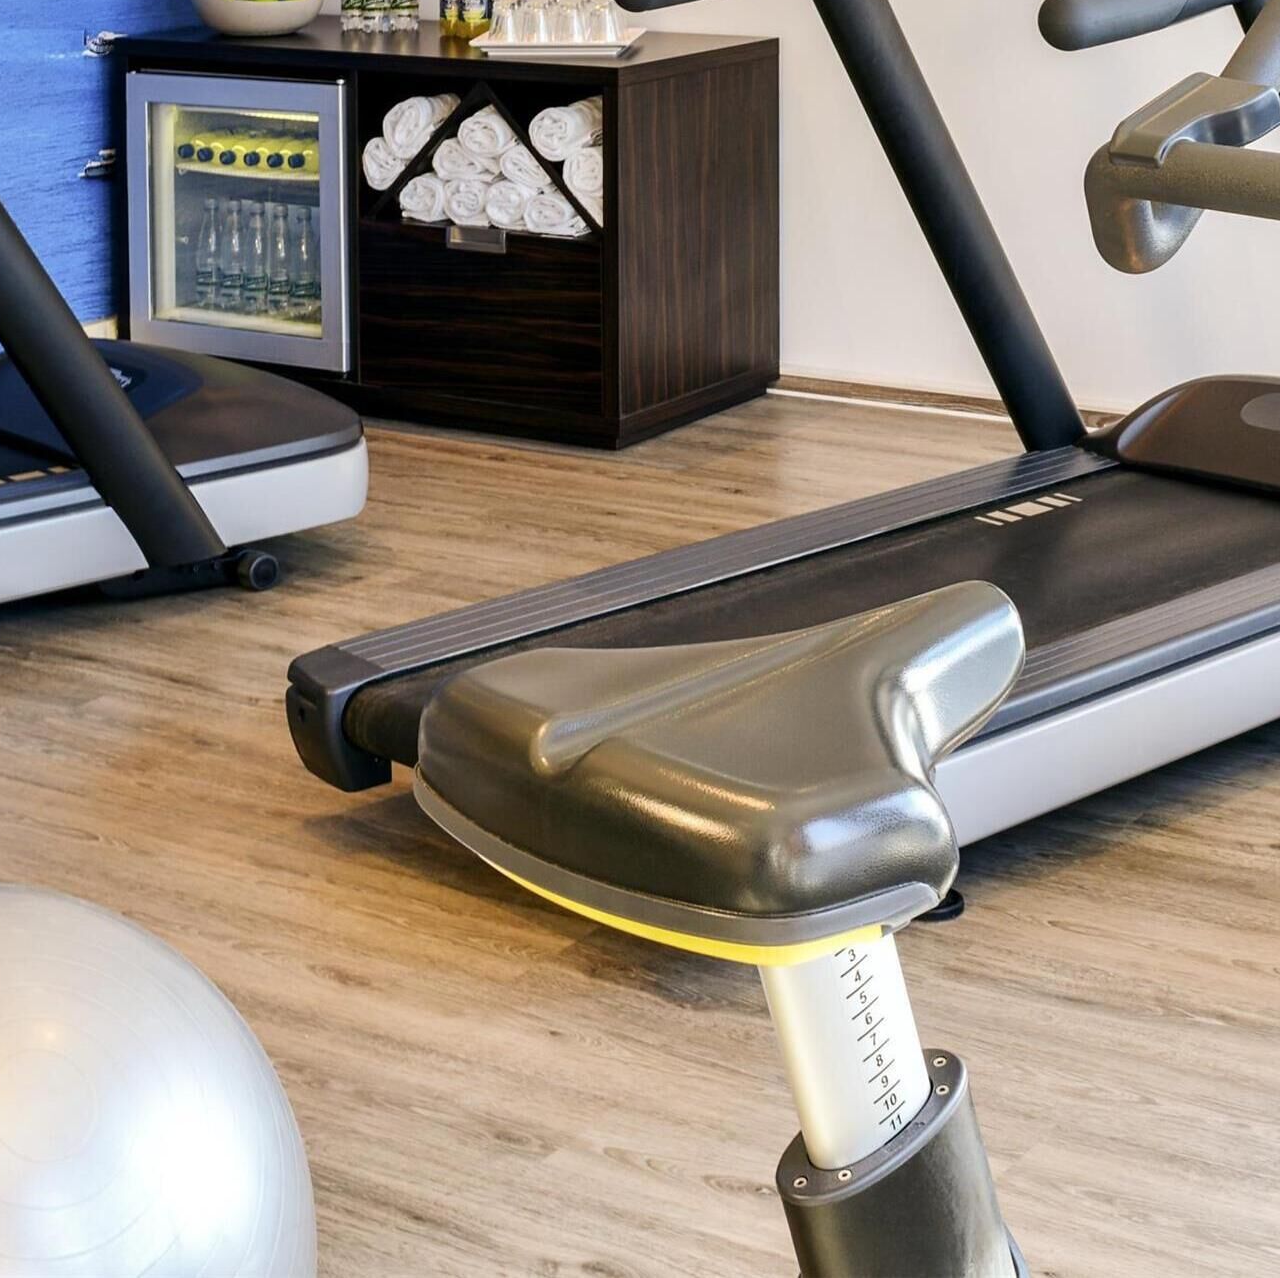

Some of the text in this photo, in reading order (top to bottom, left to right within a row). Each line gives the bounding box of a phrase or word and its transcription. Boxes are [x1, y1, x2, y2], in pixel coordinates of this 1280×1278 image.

[848, 948, 856, 962] 3
[854, 969, 861, 982] 4
[859, 990, 867, 1004] 5
[865, 1012, 873, 1025] 6
[869, 1032, 876, 1046] 7
[875, 1054, 883, 1067] 8
[880, 1075, 888, 1088] 9
[883, 1093, 897, 1110] 10
[889, 1114, 902, 1130] 11
